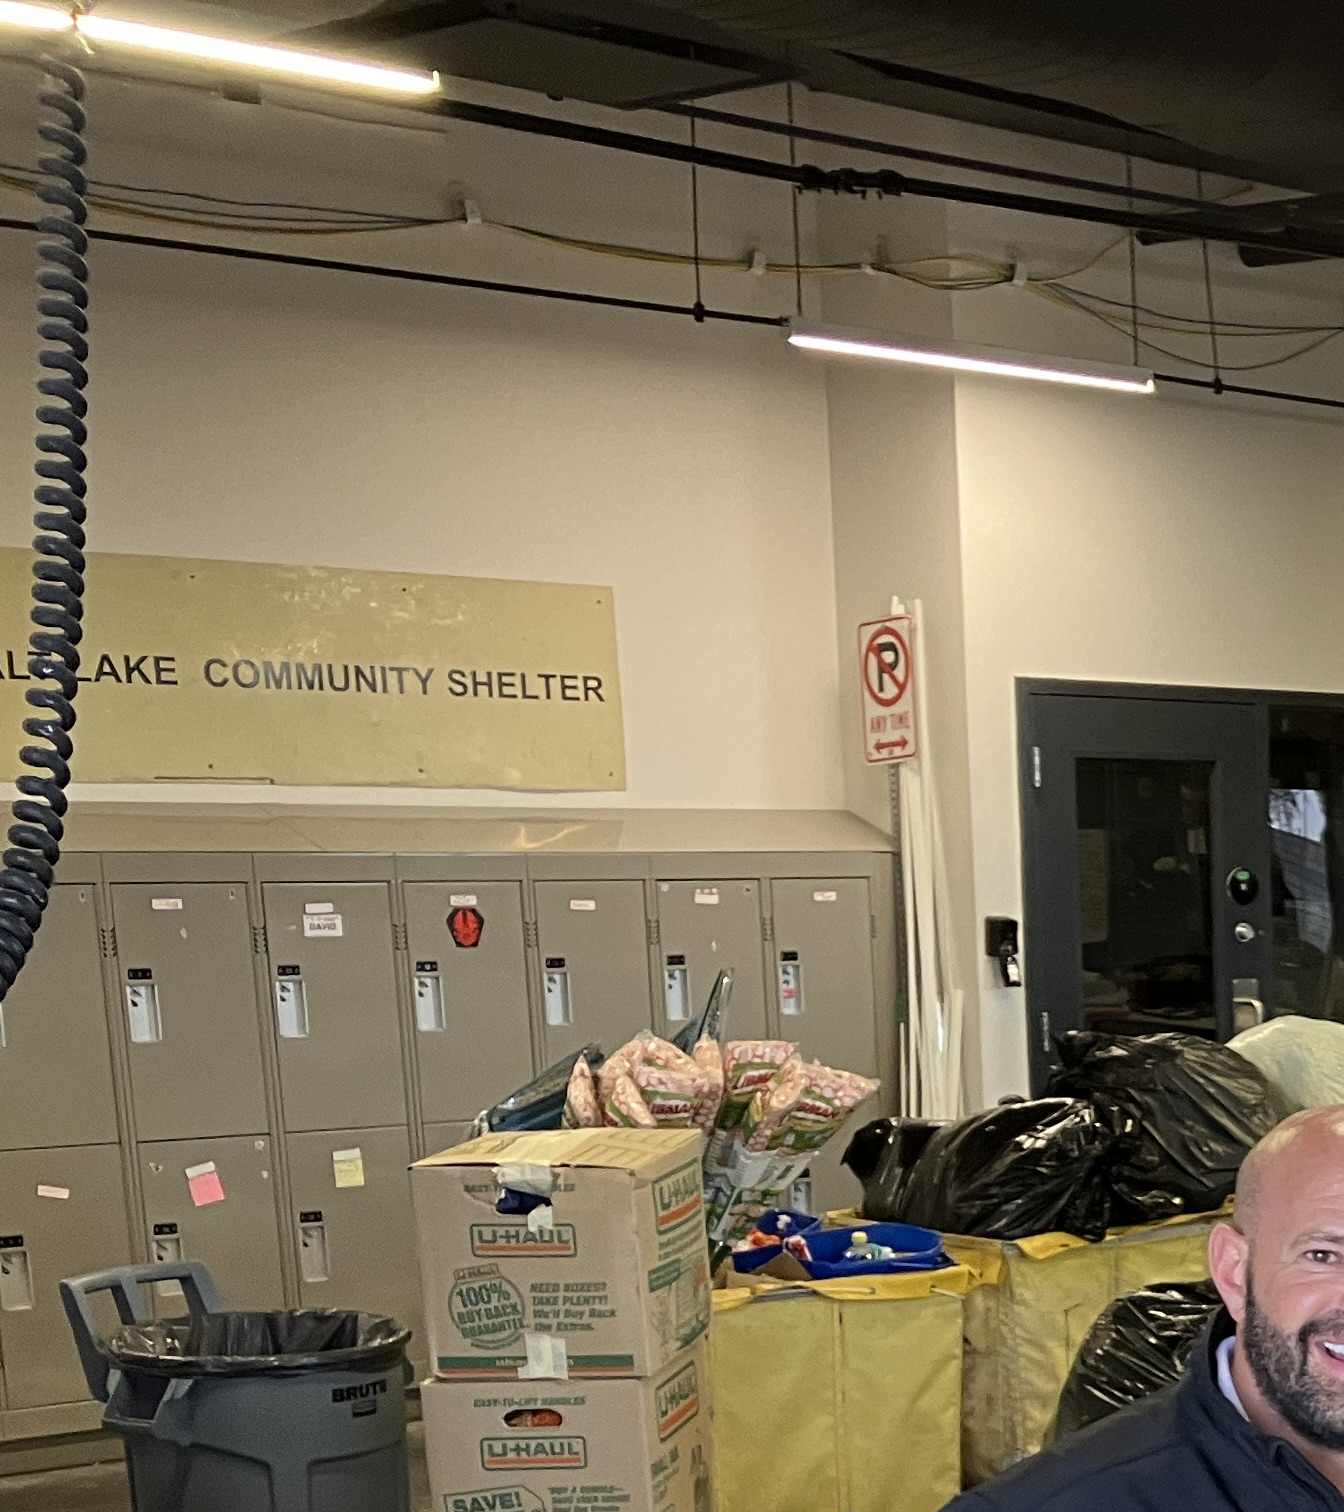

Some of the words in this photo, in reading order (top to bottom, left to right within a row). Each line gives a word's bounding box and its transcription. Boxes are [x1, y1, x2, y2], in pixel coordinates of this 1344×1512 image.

[203, 658, 434, 695] COMMUNITY
[447, 669, 605, 702] SHELTER
[477, 1229, 571, 1244] U-HAUL
[456, 1280, 510, 1308] 100%
[457, 1308, 483, 1325] BUY
[487, 1441, 581, 1458] U-HAUL
